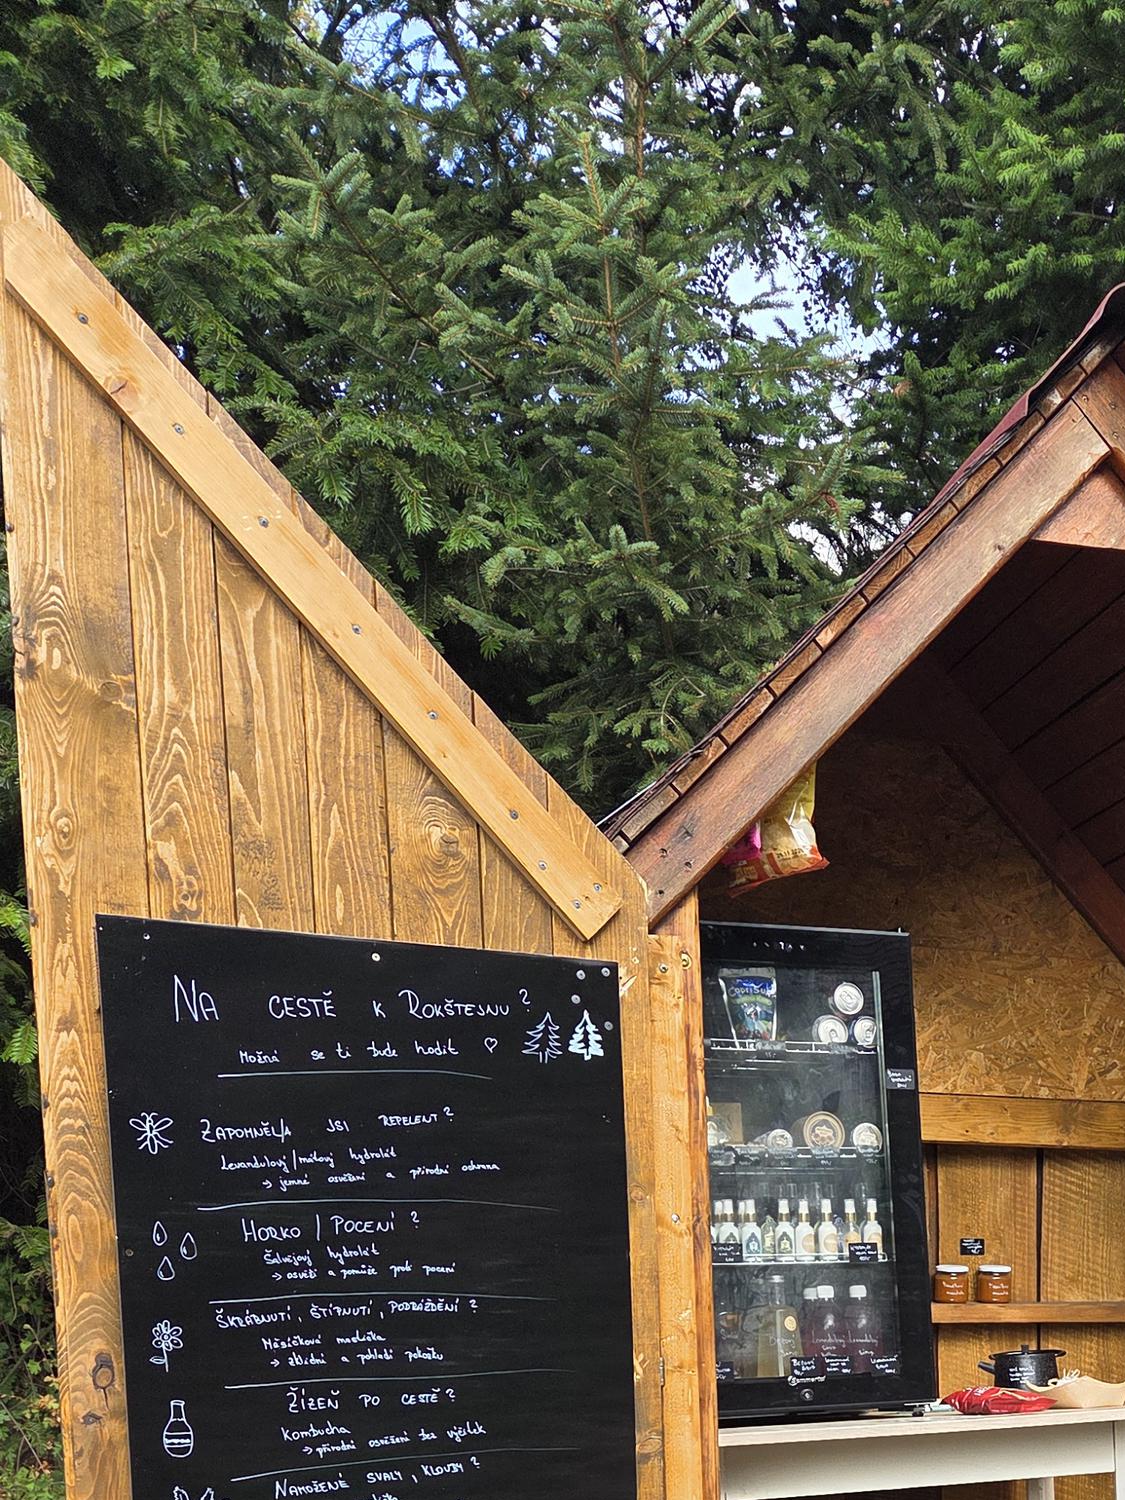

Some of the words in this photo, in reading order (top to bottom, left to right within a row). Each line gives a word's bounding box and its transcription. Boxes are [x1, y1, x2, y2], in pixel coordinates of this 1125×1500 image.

[173, 974, 220, 1023] NA
[268, 990, 338, 1020] CESTĚ
[238, 1049, 281, 1064] Možná
[310, 1049, 326, 1061] se
[335, 1041, 352, 1060] ti
[367, 1040, 399, 1059] bude
[414, 1037, 460, 1056] hodit
[326, 1117, 351, 1133] JSI
[348, 1145, 398, 1165] hydrolát
[278, 1172, 311, 1192] jemné
[385, 1171, 397, 1179] a
[460, 1159, 501, 1173] ochrana
[241, 1217, 302, 1243] HORKO
[329, 1210, 396, 1236] POCENÍ
[263, 1248, 312, 1267] Šalvějový
[326, 1242, 380, 1266] hydrolát
[327, 1269, 336, 1277] a
[341, 1264, 379, 1280] pomůže
[421, 1262, 455, 1277] pocení
[261, 1333, 322, 1352] Měsíčková
[287, 1350, 327, 1368] zklidní
[340, 1354, 351, 1364] a
[285, 1386, 341, 1414] ŽÍZEŇ
[358, 1393, 382, 1409] PO
[280, 1420, 352, 1442] Kombucha
[418, 1427, 438, 1442] bez
[274, 1472, 350, 1500] NAMOŽENÉ
